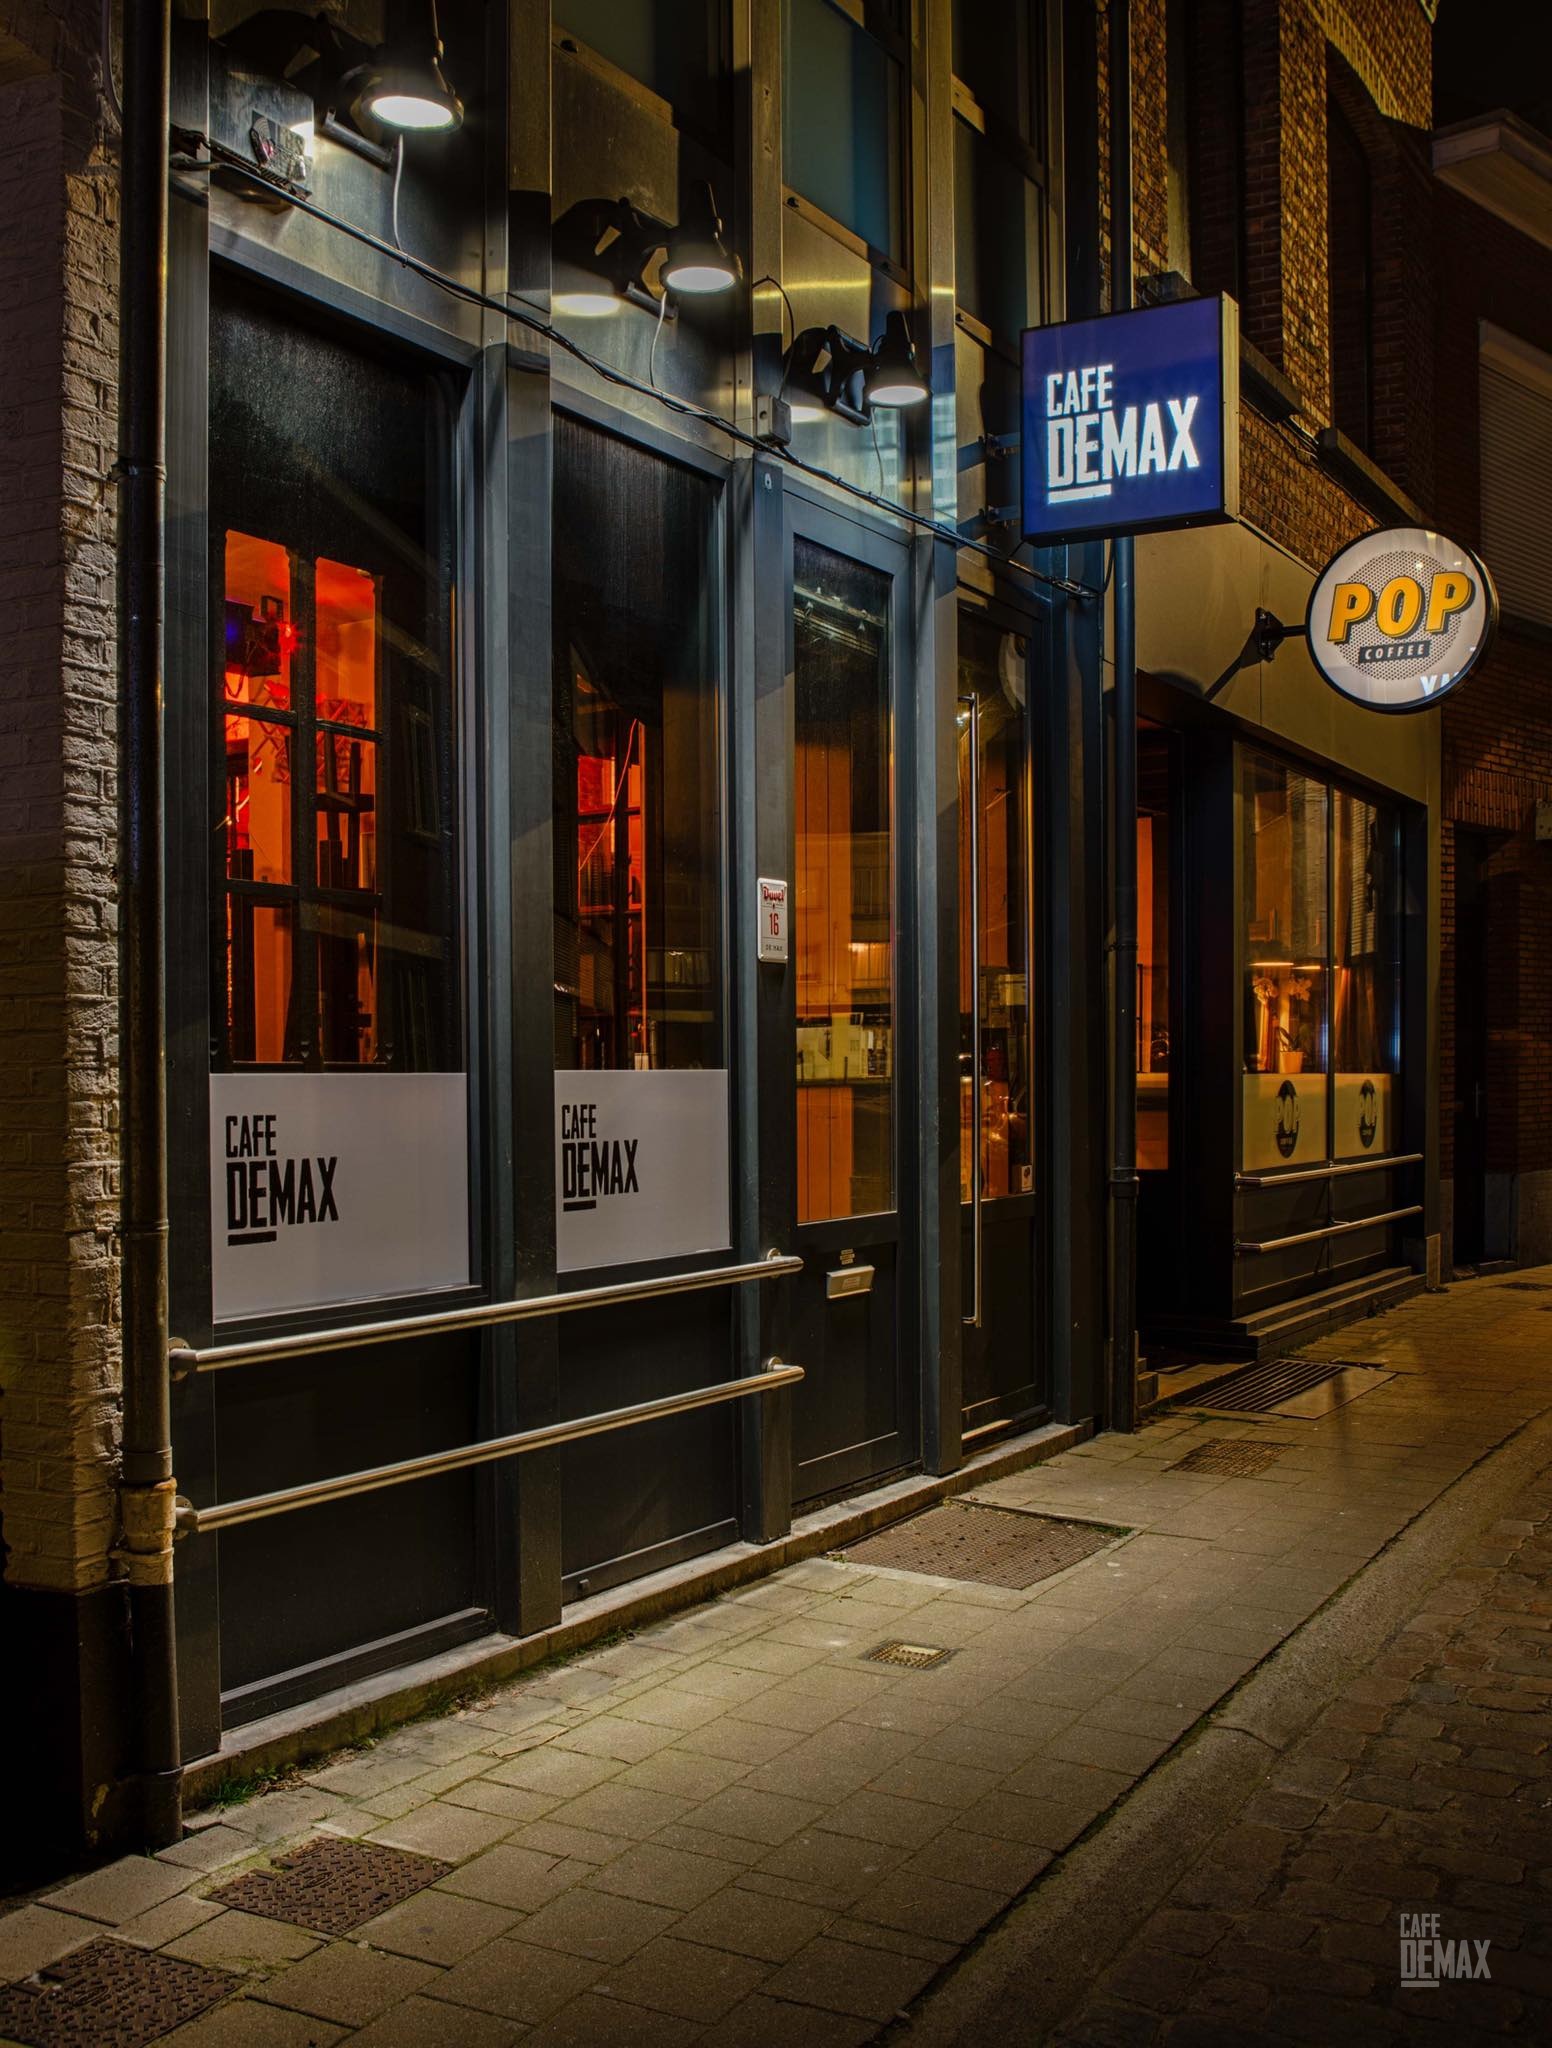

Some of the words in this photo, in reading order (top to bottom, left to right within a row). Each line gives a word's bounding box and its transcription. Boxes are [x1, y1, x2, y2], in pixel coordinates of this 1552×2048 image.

[1047, 364, 1113, 417] CAFE
[1047, 396, 1200, 488] DEMAX
[1327, 571, 1476, 645] POP
[1364, 643, 1425, 660] COFFEE
[763, 886, 784, 901] Duvel
[769, 913, 780, 935] 16
[226, 1115, 277, 1158] CAFE
[561, 1104, 597, 1139] CAFE
[226, 1156, 339, 1230] DEMAX
[562, 1139, 639, 1199] DEMAX
